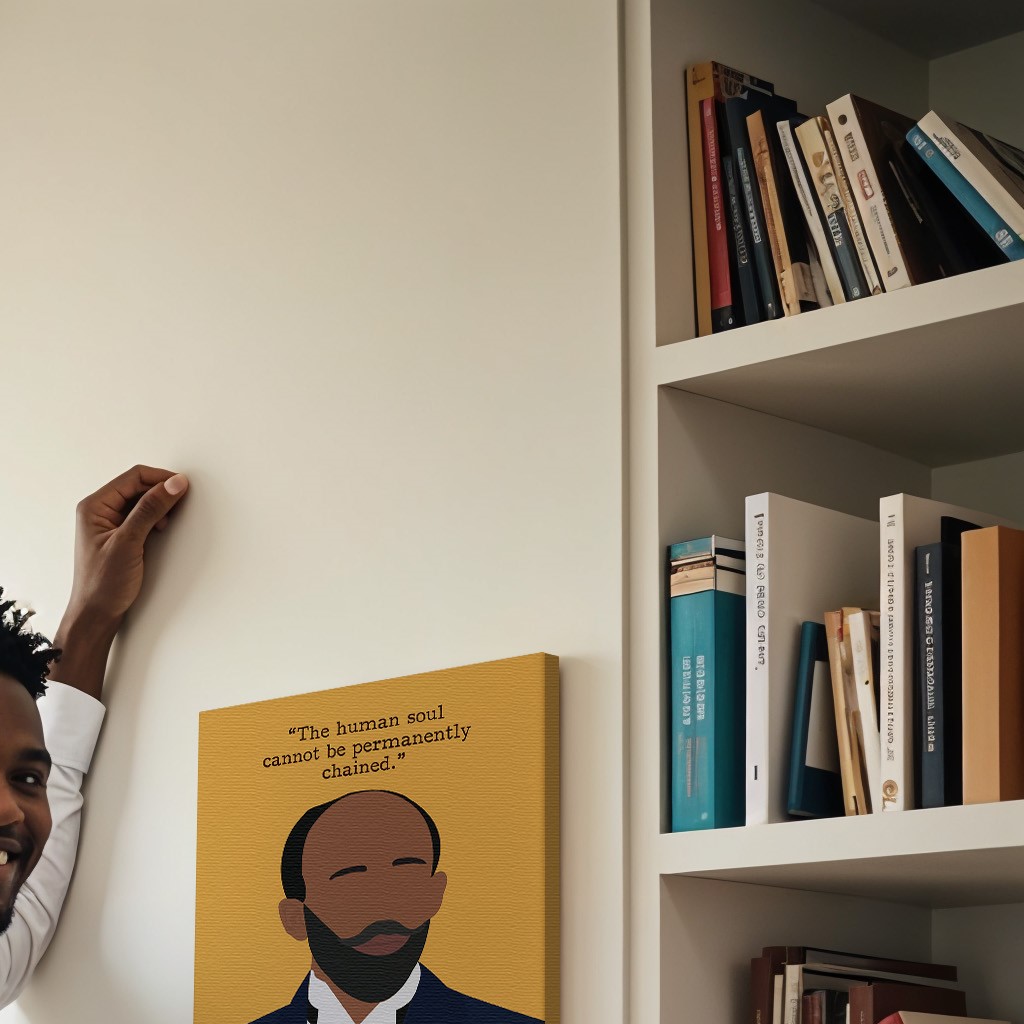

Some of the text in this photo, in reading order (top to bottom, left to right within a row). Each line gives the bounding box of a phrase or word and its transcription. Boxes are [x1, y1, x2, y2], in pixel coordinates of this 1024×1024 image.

[288, 704, 445, 742] “The human soul
[262, 723, 471, 768] cannot be permanently
[322, 752, 406, 780] chained.”
